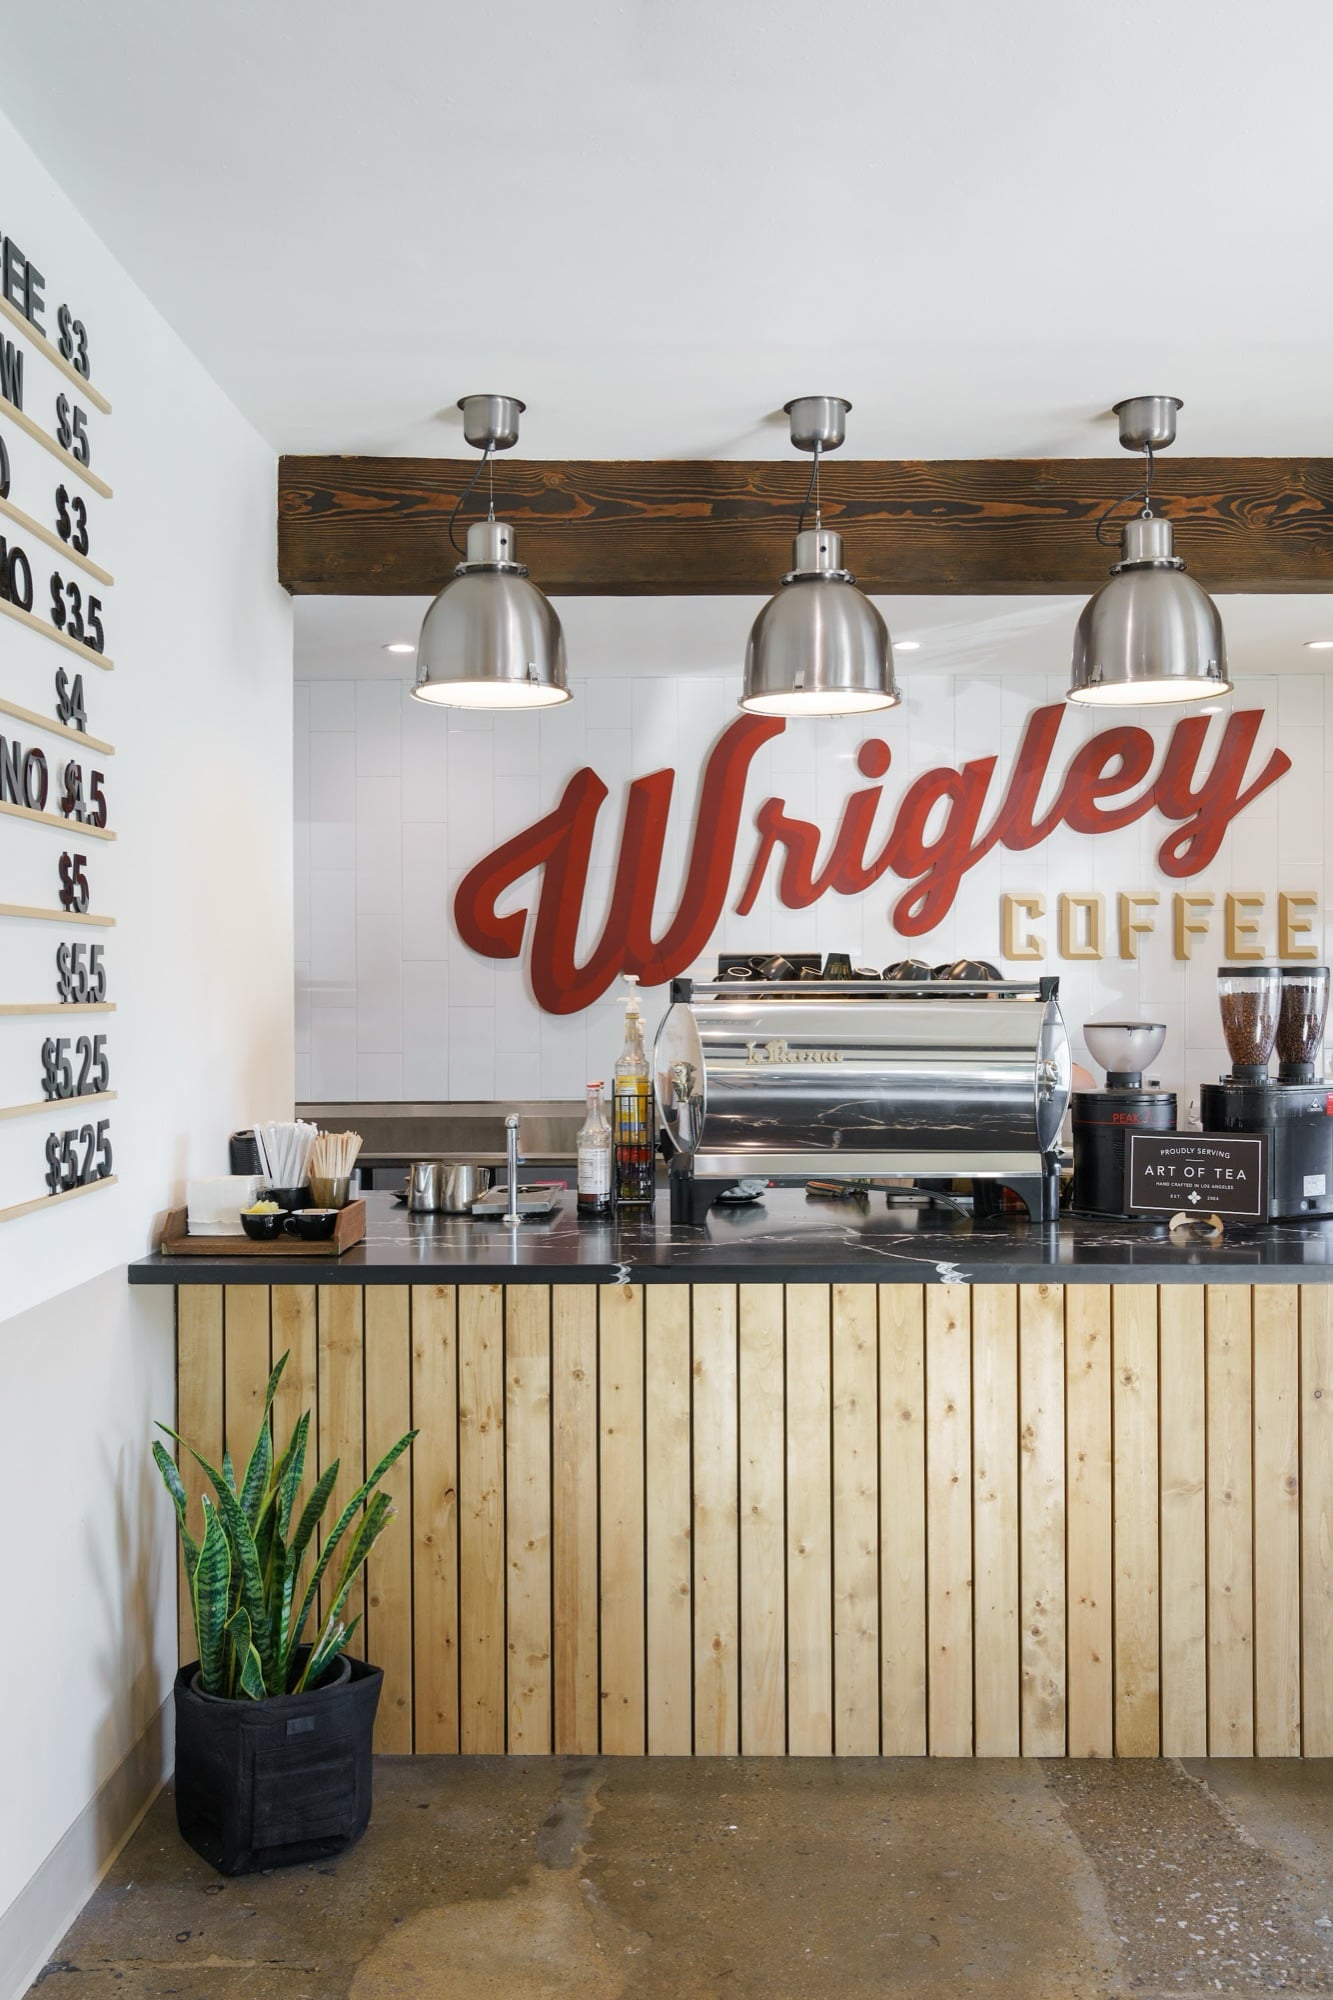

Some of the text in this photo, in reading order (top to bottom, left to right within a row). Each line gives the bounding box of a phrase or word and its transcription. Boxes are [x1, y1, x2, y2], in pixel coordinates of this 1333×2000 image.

[0, 231, 90, 381] EE $3
[56, 392, 90, 468] $5
[55, 484, 89, 557] $3
[55, 666, 88, 735] $4
[58, 851, 90, 914] $5
[452, 704, 1292, 1015] Wrigley
[1002, 891, 1318, 961] COFFEE
[56, 942, 107, 1005] $5.5
[1111, 1113, 1140, 1124] PEAK
[1160, 1147, 1231, 1159] PROUDLY SERVING
[1144, 1165, 1247, 1180] ART OF TEA
